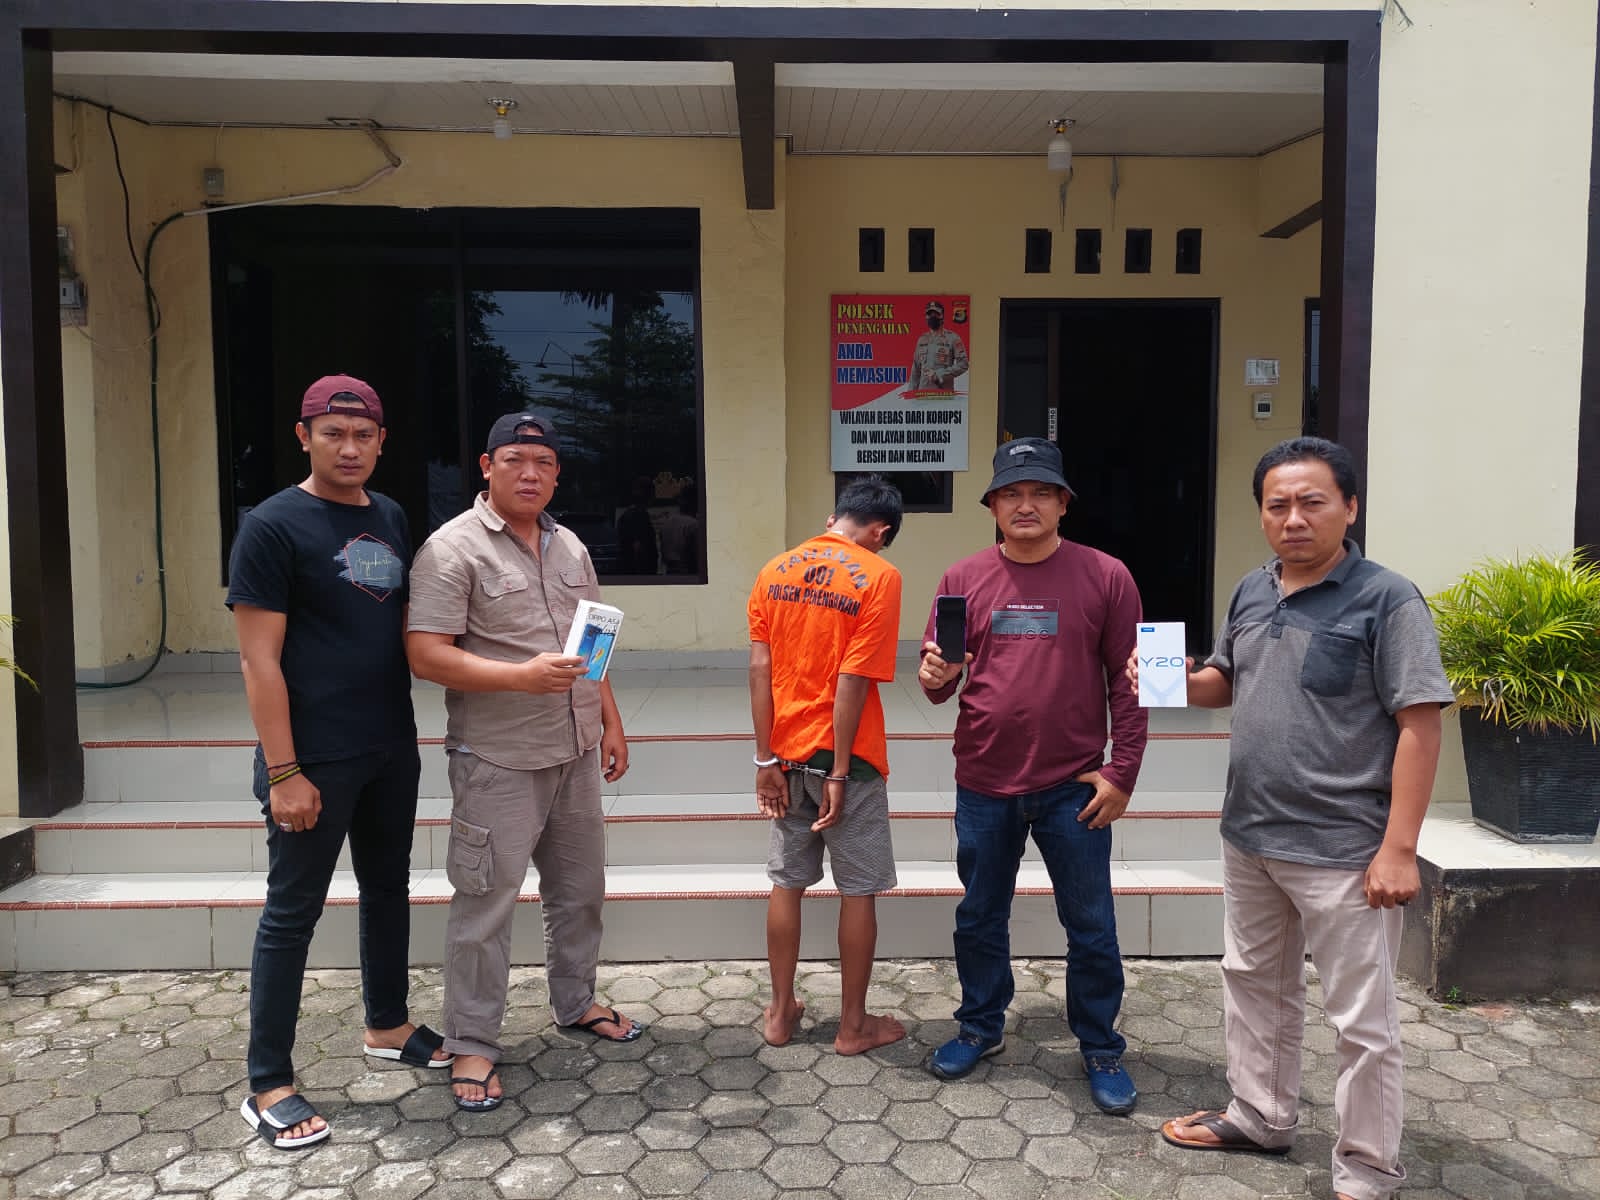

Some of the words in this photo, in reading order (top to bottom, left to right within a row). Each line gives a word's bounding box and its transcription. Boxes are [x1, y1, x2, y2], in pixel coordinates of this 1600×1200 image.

[837, 303, 894, 319] POLSEK
[837, 322, 910, 335] PENENGAHAN
[837, 343, 873, 360] ANDA
[837, 366, 907, 384] MEMASUKI
[840, 410, 876, 425] WILAYAH
[877, 410, 904, 425] BEBAS
[905, 410, 925, 425] DARI
[926, 410, 962, 425] KORUPSI
[851, 429, 868, 444] DAN
[869, 429, 905, 444] WILAYAH
[906, 429, 951, 444] BIROKRASI
[856, 449, 887, 464] BERSIH
[888, 449, 905, 464] DAN
[906, 449, 945, 464] MELAYANI
[776, 546, 869, 590] TAHANAN
[803, 565, 836, 586] 001
[768, 584, 801, 602] POLSEK
[588, 614, 606, 622] OPPO
[1140, 656, 1185, 668] Y20
